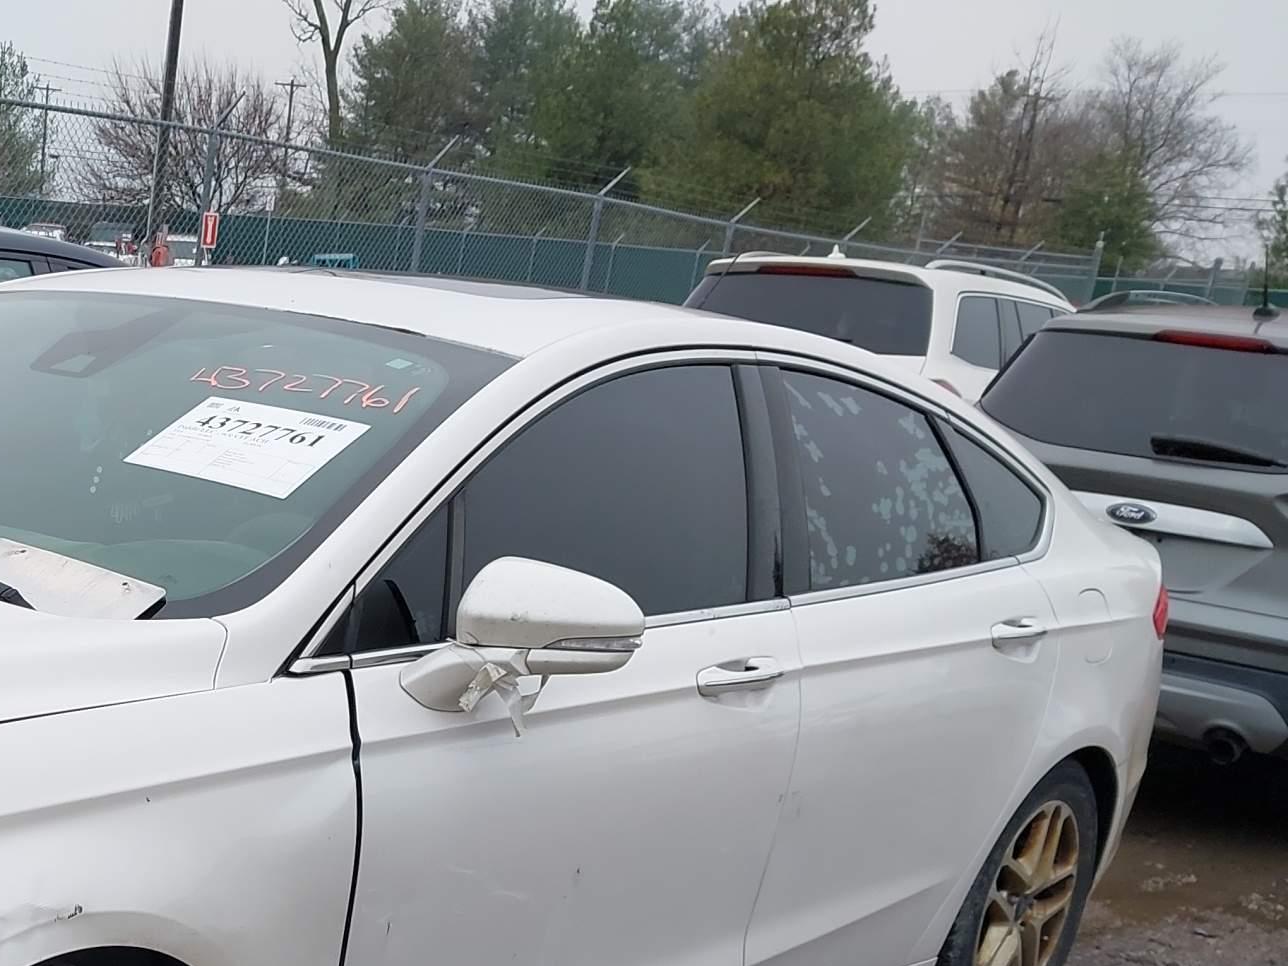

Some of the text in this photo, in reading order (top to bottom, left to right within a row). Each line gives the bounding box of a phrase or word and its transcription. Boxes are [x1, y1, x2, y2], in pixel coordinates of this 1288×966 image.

[190, 366, 421, 414] 43727761
[196, 415, 325, 448] 43727761
[1116, 505, 1144, 520] Ford
